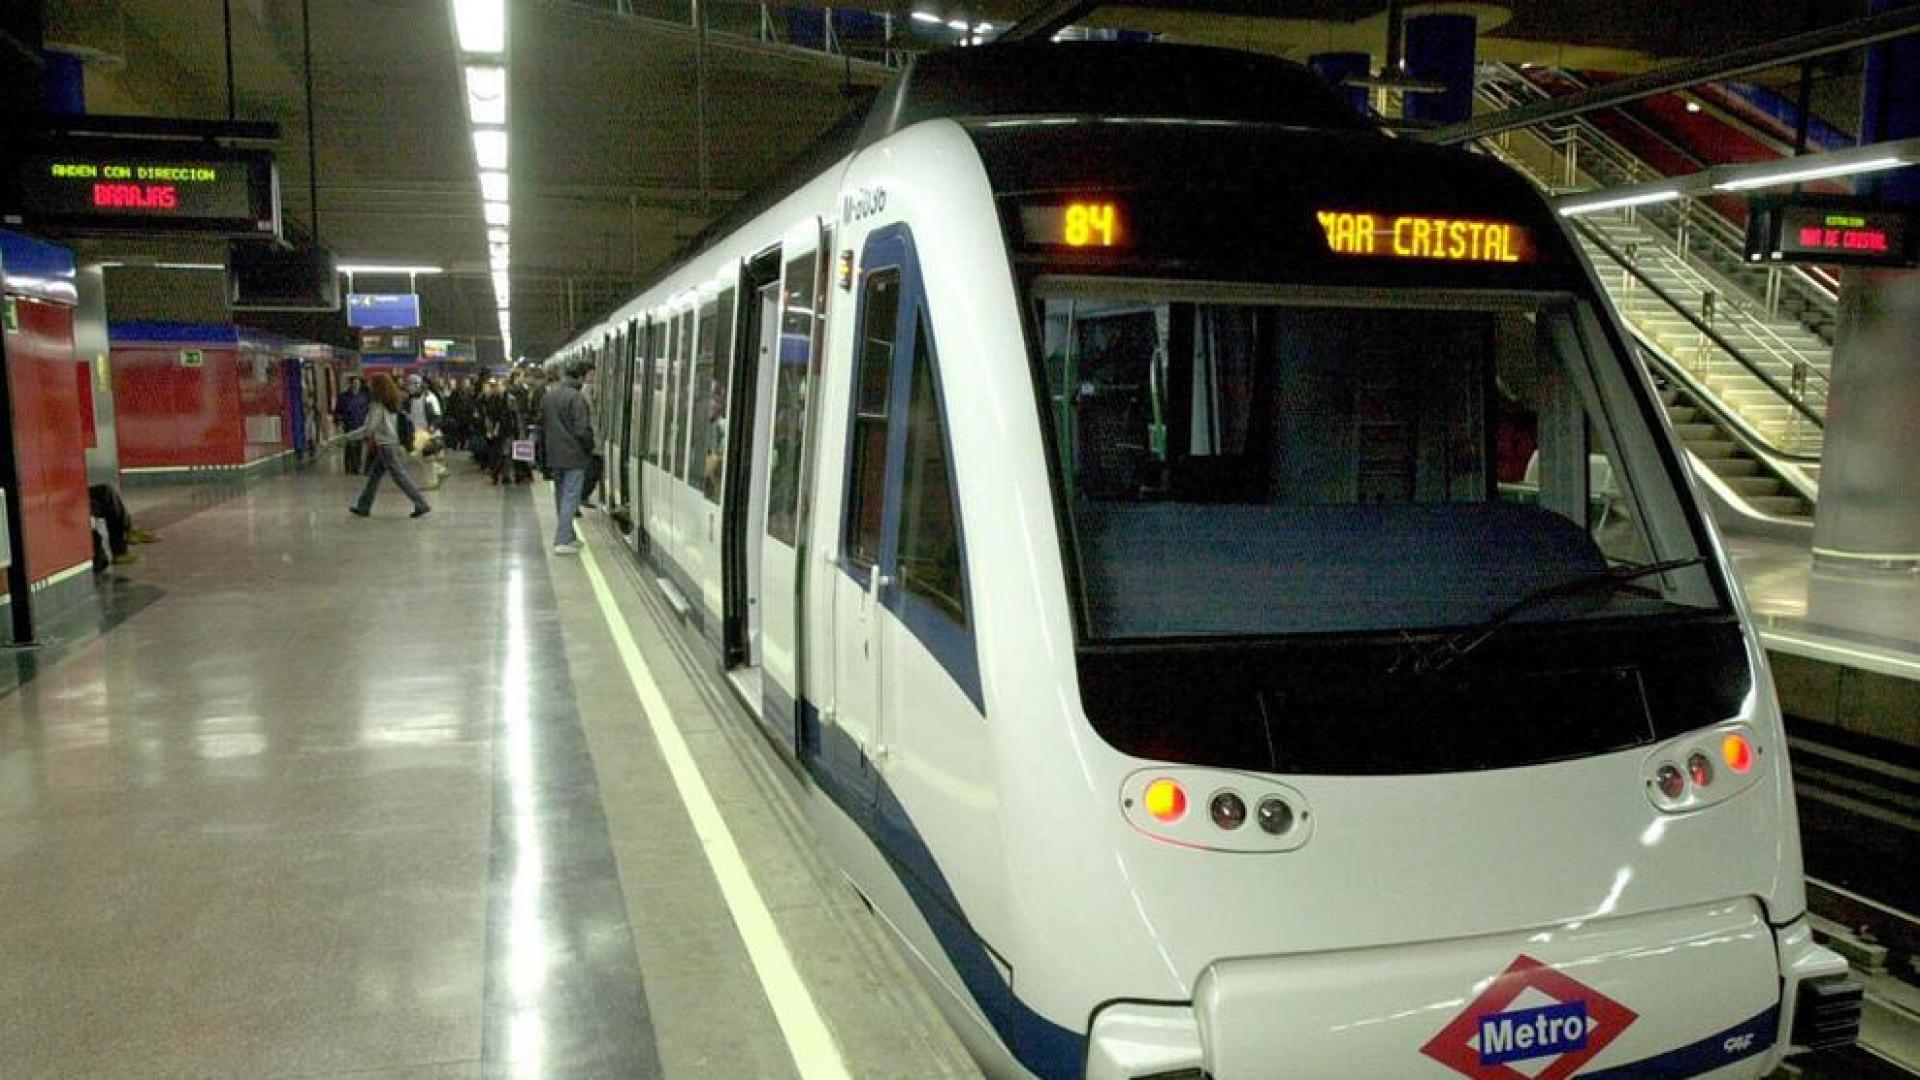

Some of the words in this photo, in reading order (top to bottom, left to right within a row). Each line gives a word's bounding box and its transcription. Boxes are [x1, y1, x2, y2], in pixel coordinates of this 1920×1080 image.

[104, 166, 131, 180] CON
[137, 167, 216, 182] DIRECCION
[1066, 203, 1112, 247] 84
[1394, 216, 1519, 263] CRISTAL
[1483, 1013, 1583, 1055] Metro
